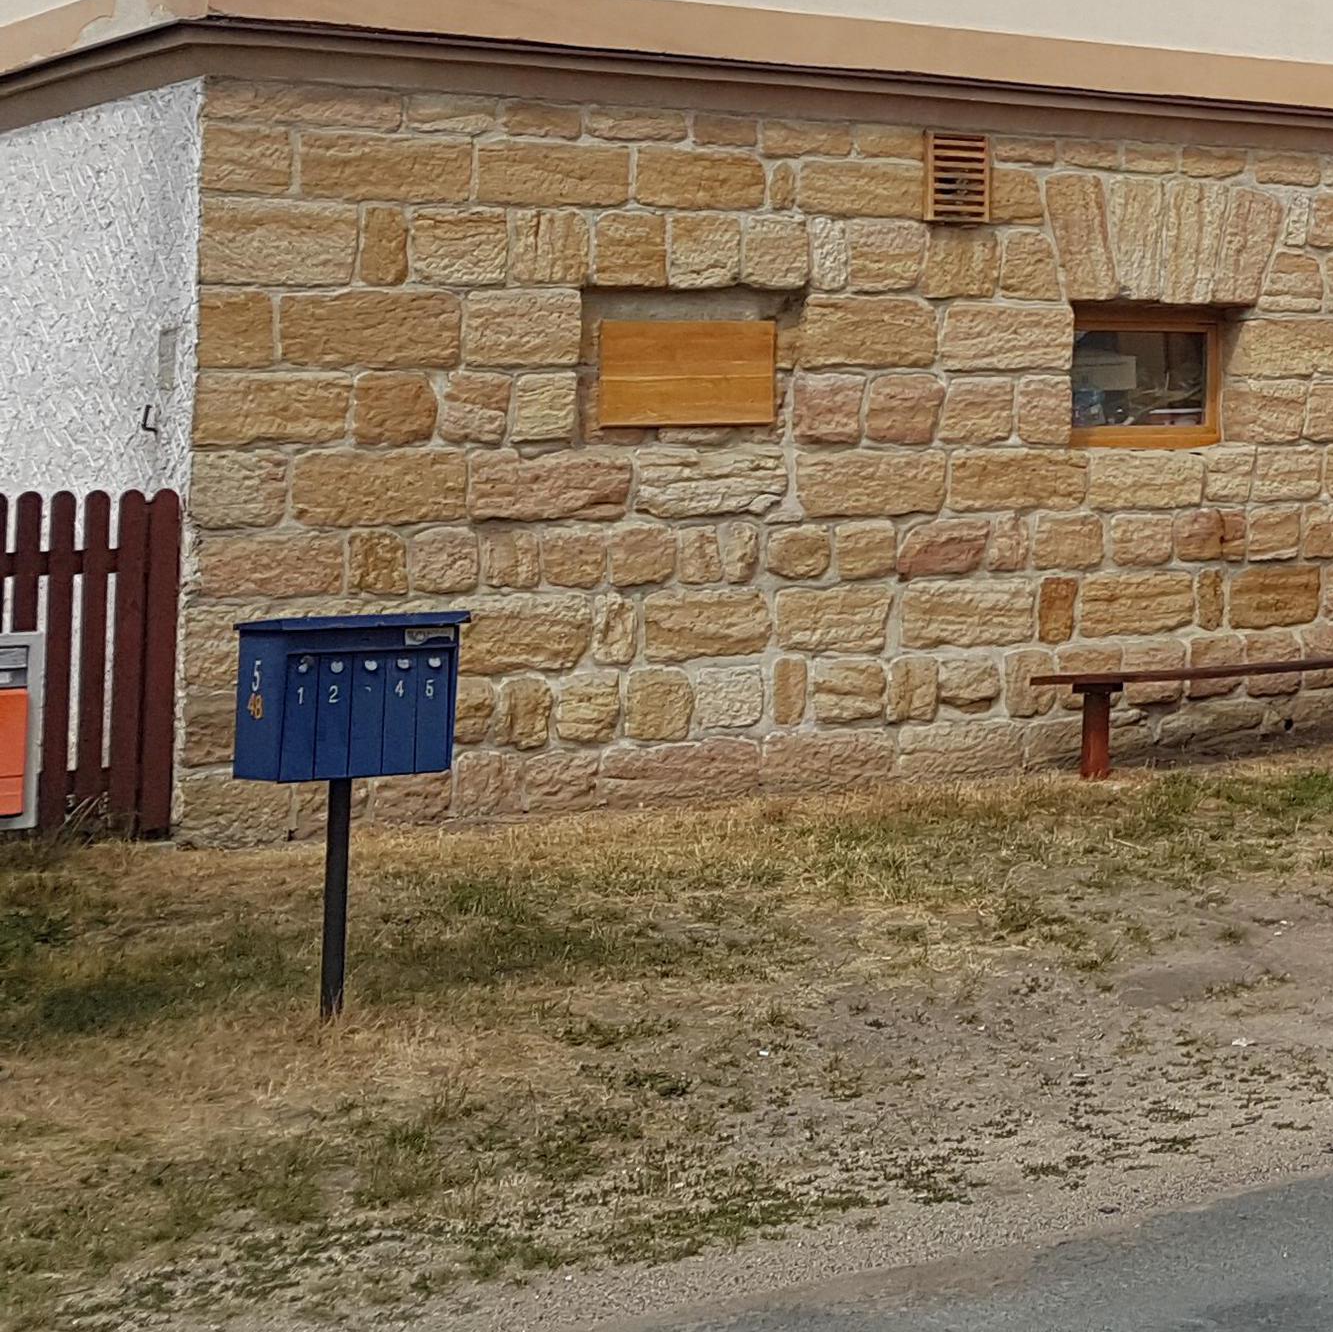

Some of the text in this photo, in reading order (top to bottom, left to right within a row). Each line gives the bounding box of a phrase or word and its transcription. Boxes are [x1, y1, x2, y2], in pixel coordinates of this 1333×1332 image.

[296, 686, 304, 705] 1
[328, 685, 341, 704] 2
[395, 680, 404, 697] 4
